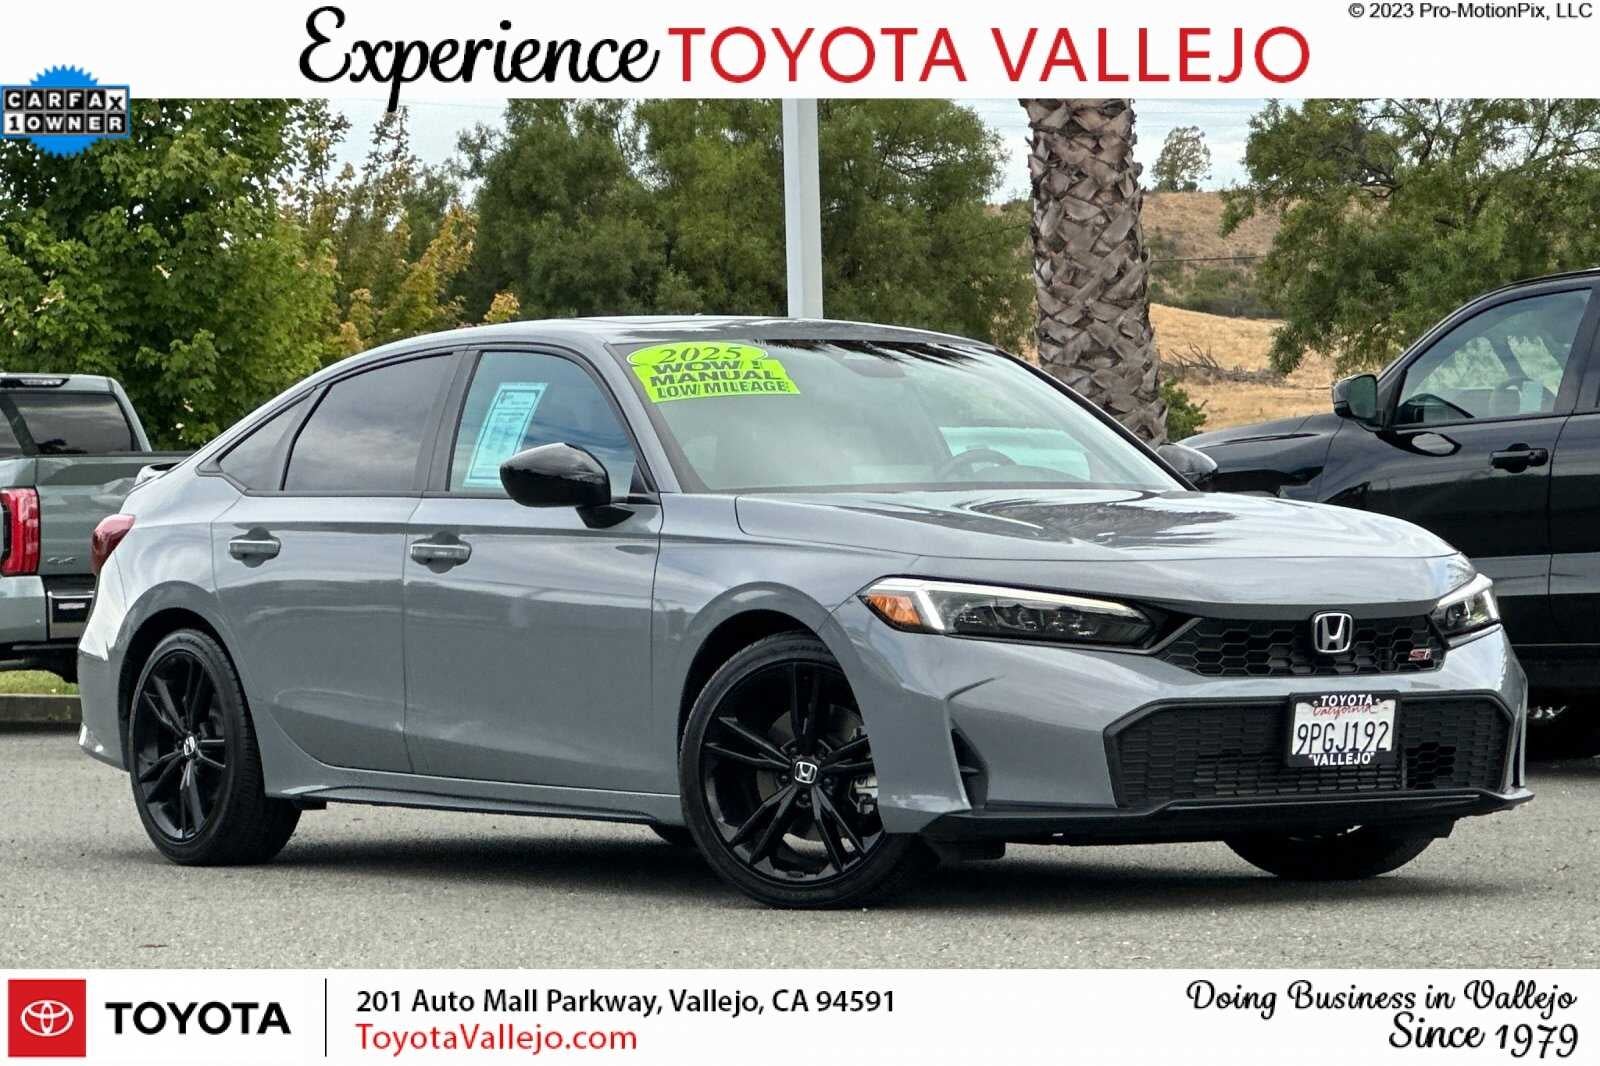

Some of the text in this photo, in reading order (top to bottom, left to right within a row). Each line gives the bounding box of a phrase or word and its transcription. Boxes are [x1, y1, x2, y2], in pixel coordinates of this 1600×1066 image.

[658, 346, 742, 364] 2025
[650, 370, 781, 387] MANUAL
[657, 380, 790, 399] LOW MILEAGE
[1321, 694, 1373, 707] TOYOTA
[1296, 721, 1389, 754] 9PGJ192
